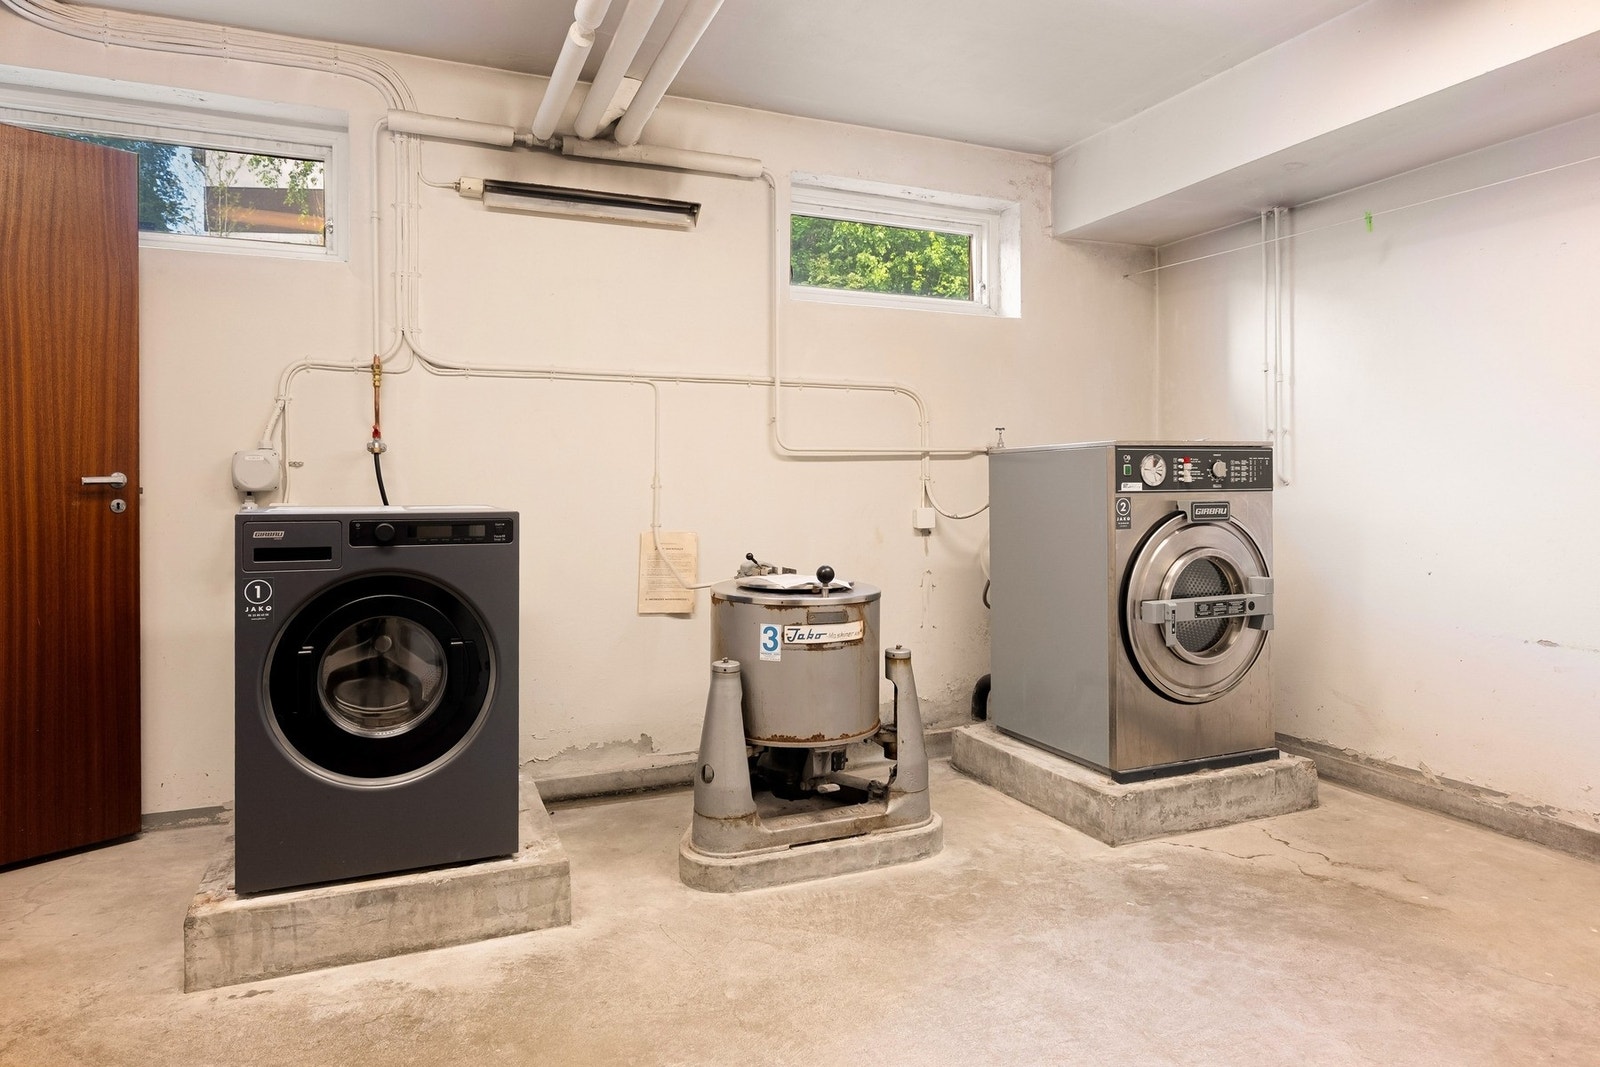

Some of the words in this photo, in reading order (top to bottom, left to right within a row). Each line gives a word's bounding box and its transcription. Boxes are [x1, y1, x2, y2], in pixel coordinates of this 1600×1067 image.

[1120, 502, 1127, 512] 2
[1195, 507, 1227, 515] GIRBAU
[254, 585, 261, 599] 1
[244, 605, 272, 613] JAKO
[762, 626, 779, 652] 3
